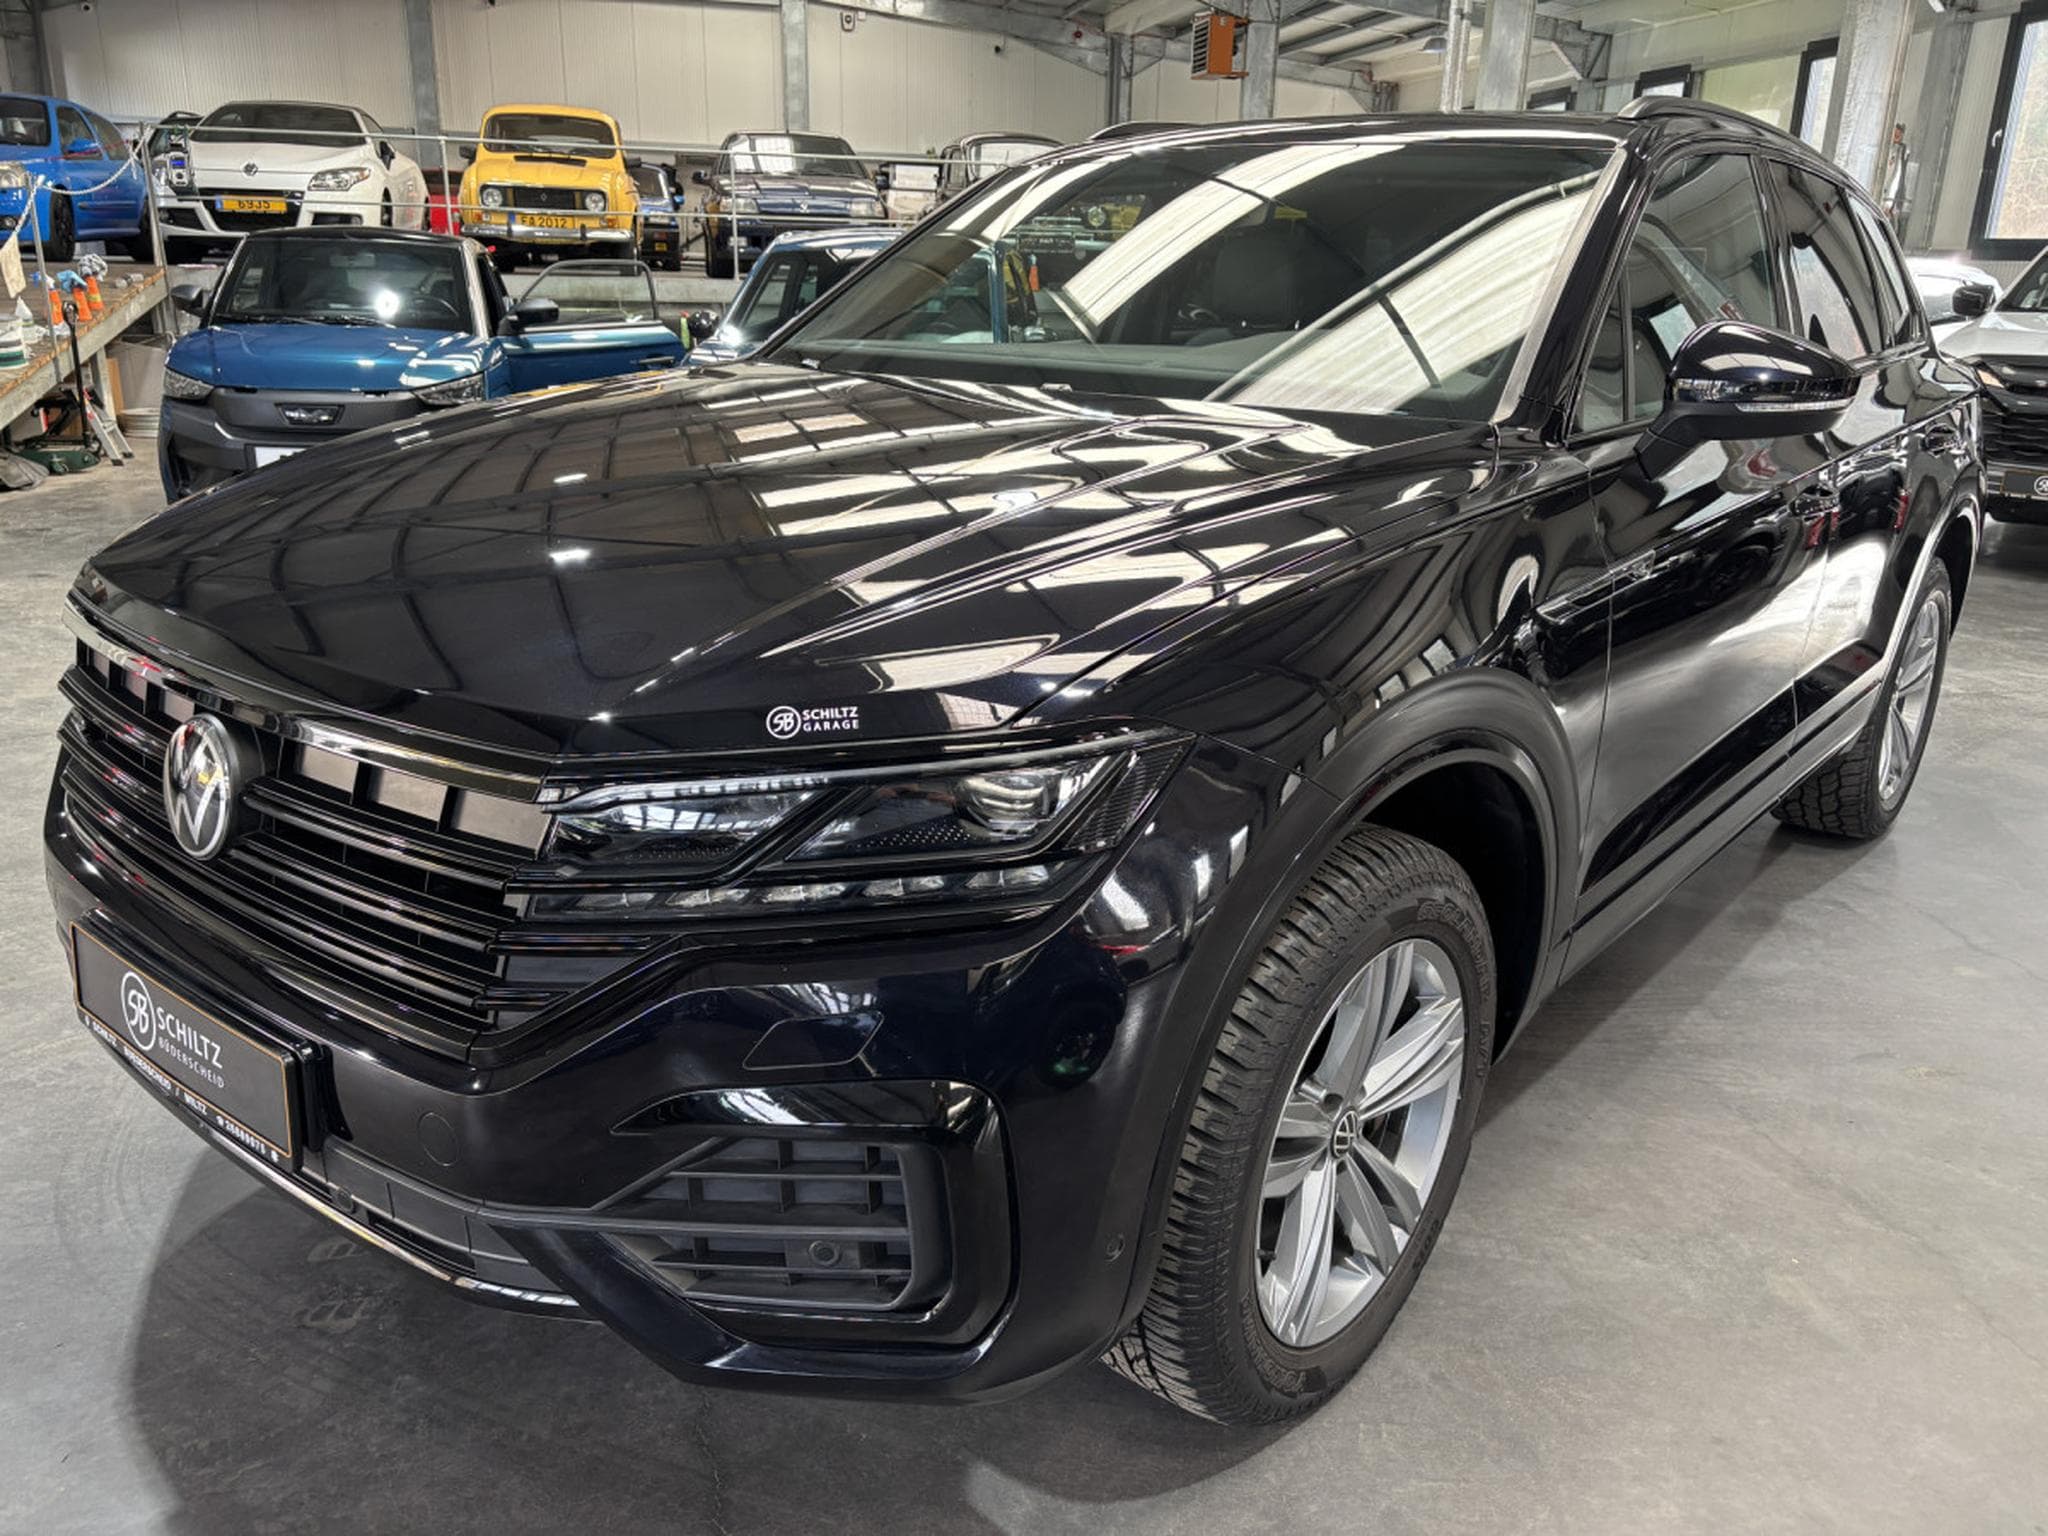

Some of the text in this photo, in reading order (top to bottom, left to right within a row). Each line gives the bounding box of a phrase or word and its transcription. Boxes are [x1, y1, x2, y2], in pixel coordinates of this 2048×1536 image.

[802, 706, 859, 721] SCHILTZ
[802, 719, 859, 732] GARAGE
[156, 1006, 223, 1069] SCHILTZ
